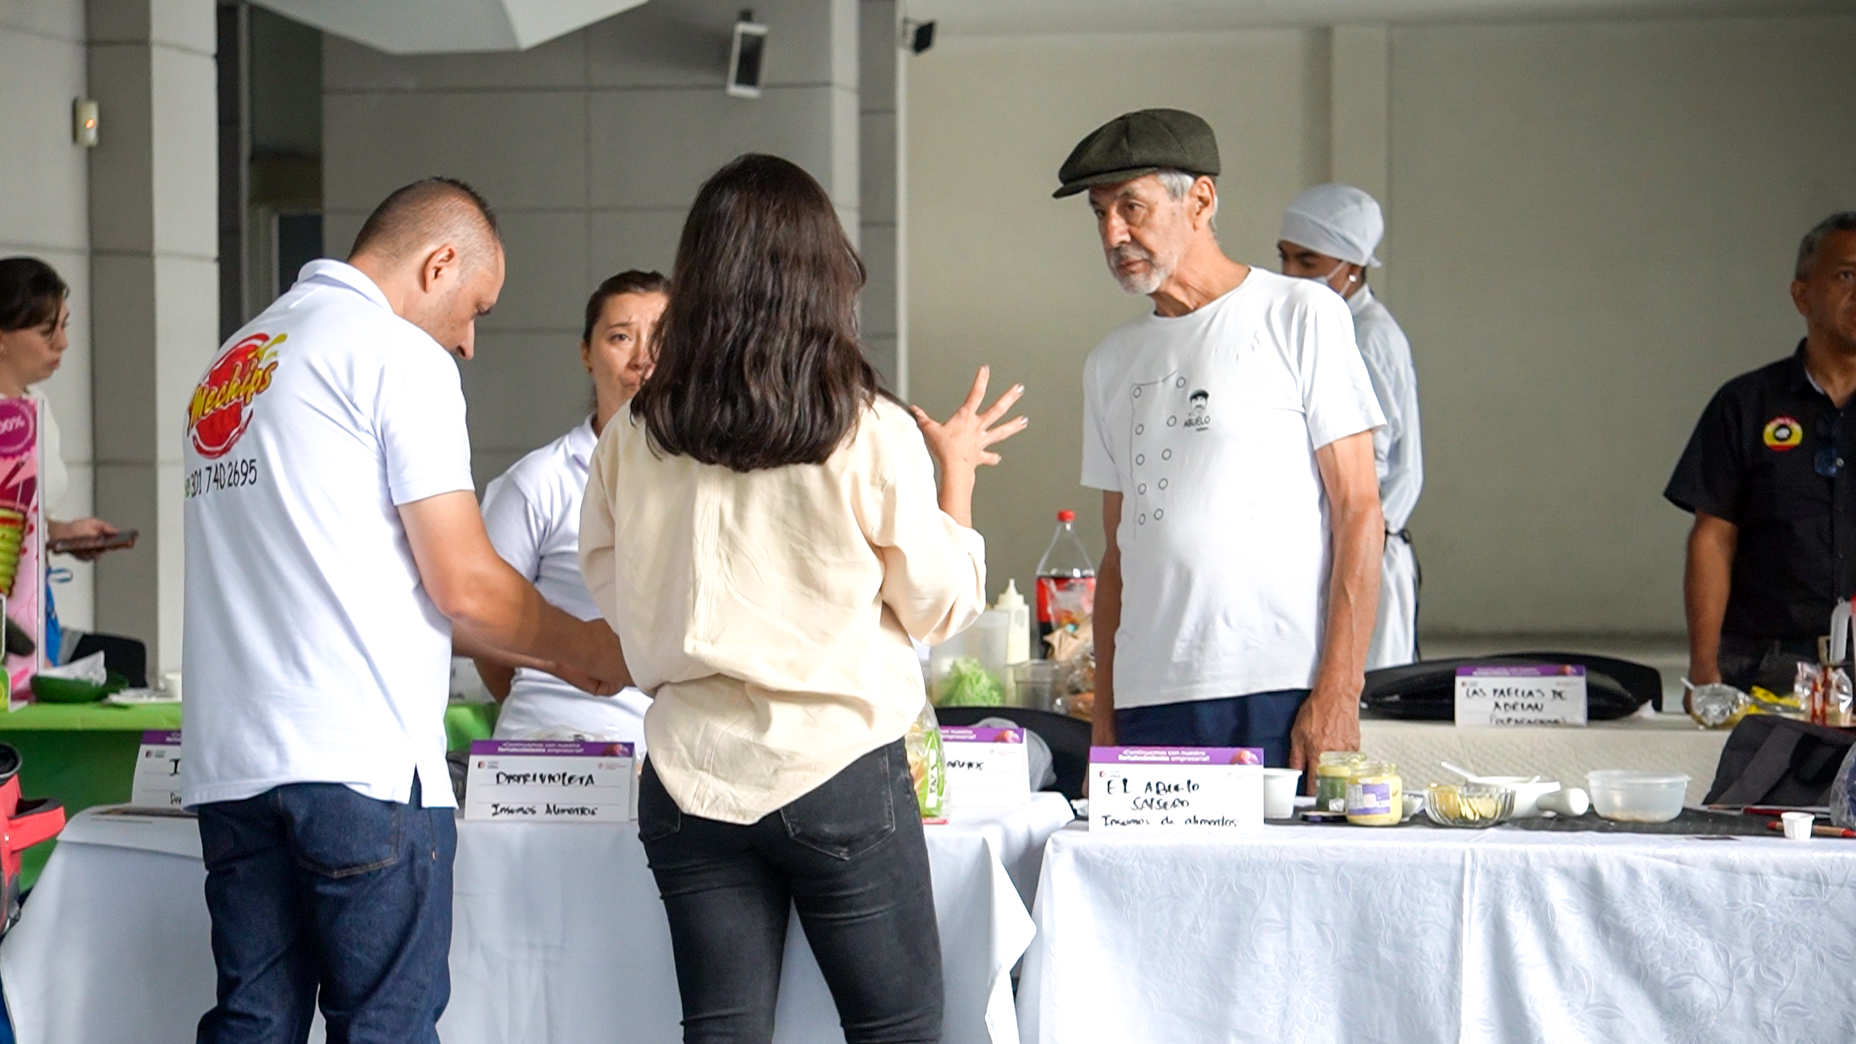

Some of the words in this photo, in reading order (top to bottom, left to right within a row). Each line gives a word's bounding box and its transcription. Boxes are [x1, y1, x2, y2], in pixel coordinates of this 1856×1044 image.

[1184, 415, 1210, 427] ABUELO
[205, 463, 226, 494] 740
[227, 459, 257, 487] 2695
[1107, 778, 1131, 795] EL
